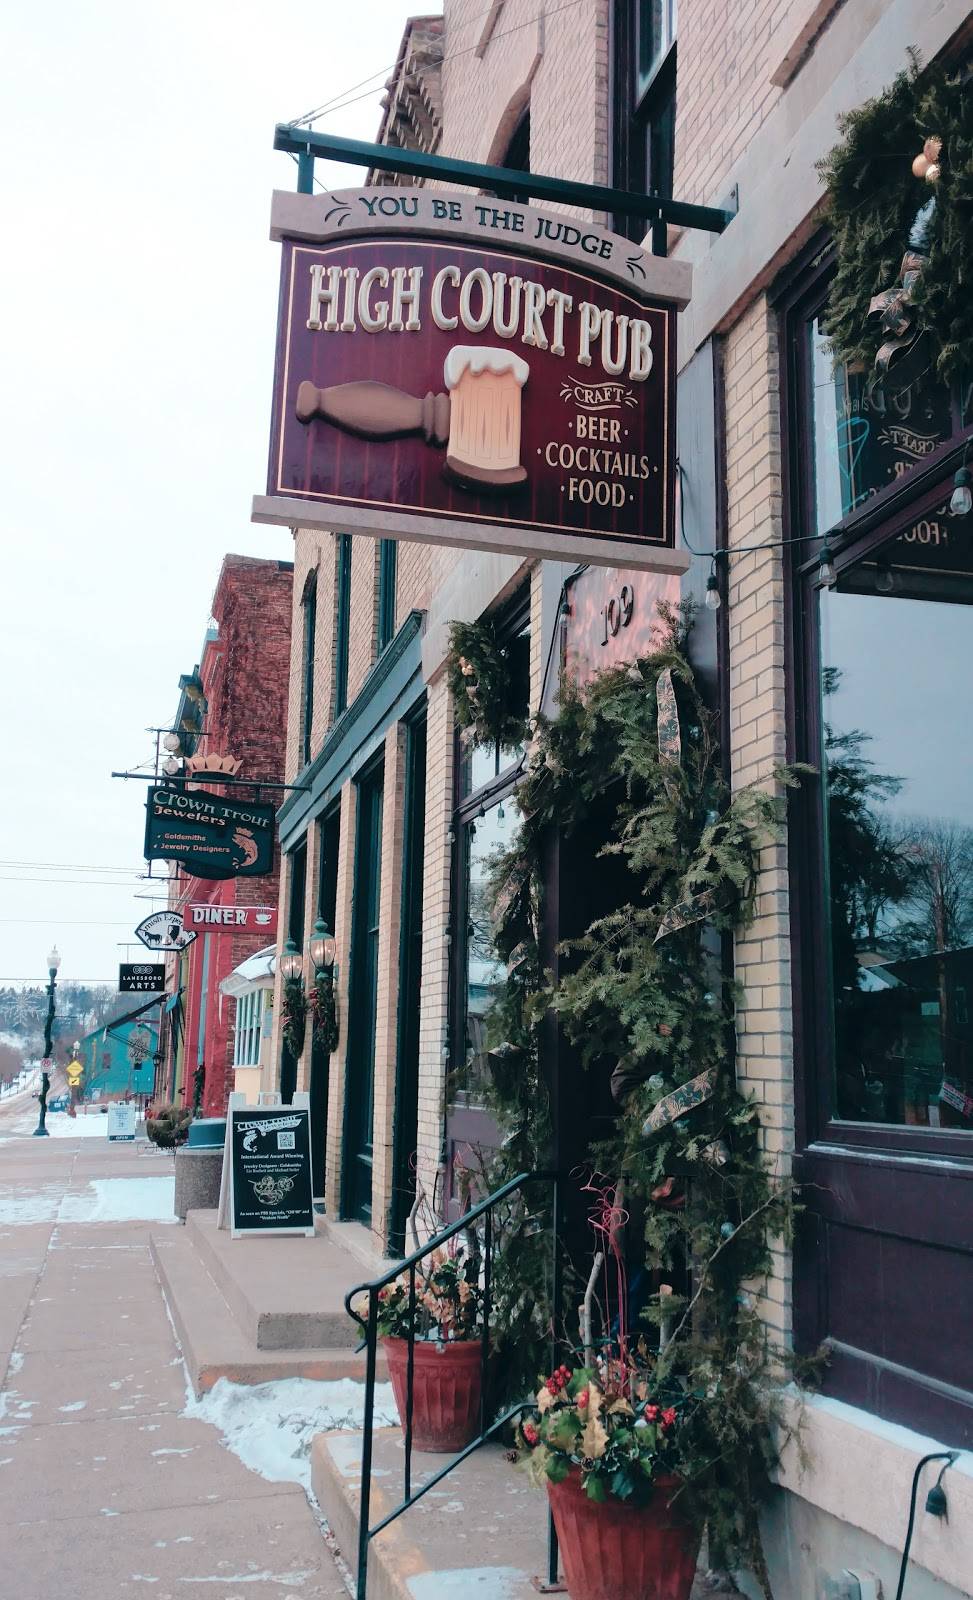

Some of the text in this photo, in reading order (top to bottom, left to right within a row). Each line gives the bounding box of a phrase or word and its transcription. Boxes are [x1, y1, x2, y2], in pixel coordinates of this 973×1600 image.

[359, 196, 613, 261] YOU BE THE JUDGE
[306, 264, 654, 382] HIGH COURT PUB
[573, 386, 625, 406] CRAFT
[575, 414, 622, 443] BEER
[545, 441, 650, 480] COCKTAILS
[568, 477, 627, 508] FOOD
[600, 584, 634, 647] 109
[153, 790, 270, 828] Crown Trout
[154, 805, 226, 826] Jewelers
[160, 843, 231, 854] Jewelry Designers
[164, 833, 206, 842] Goldsmiths
[191, 908, 248, 925] DINER
